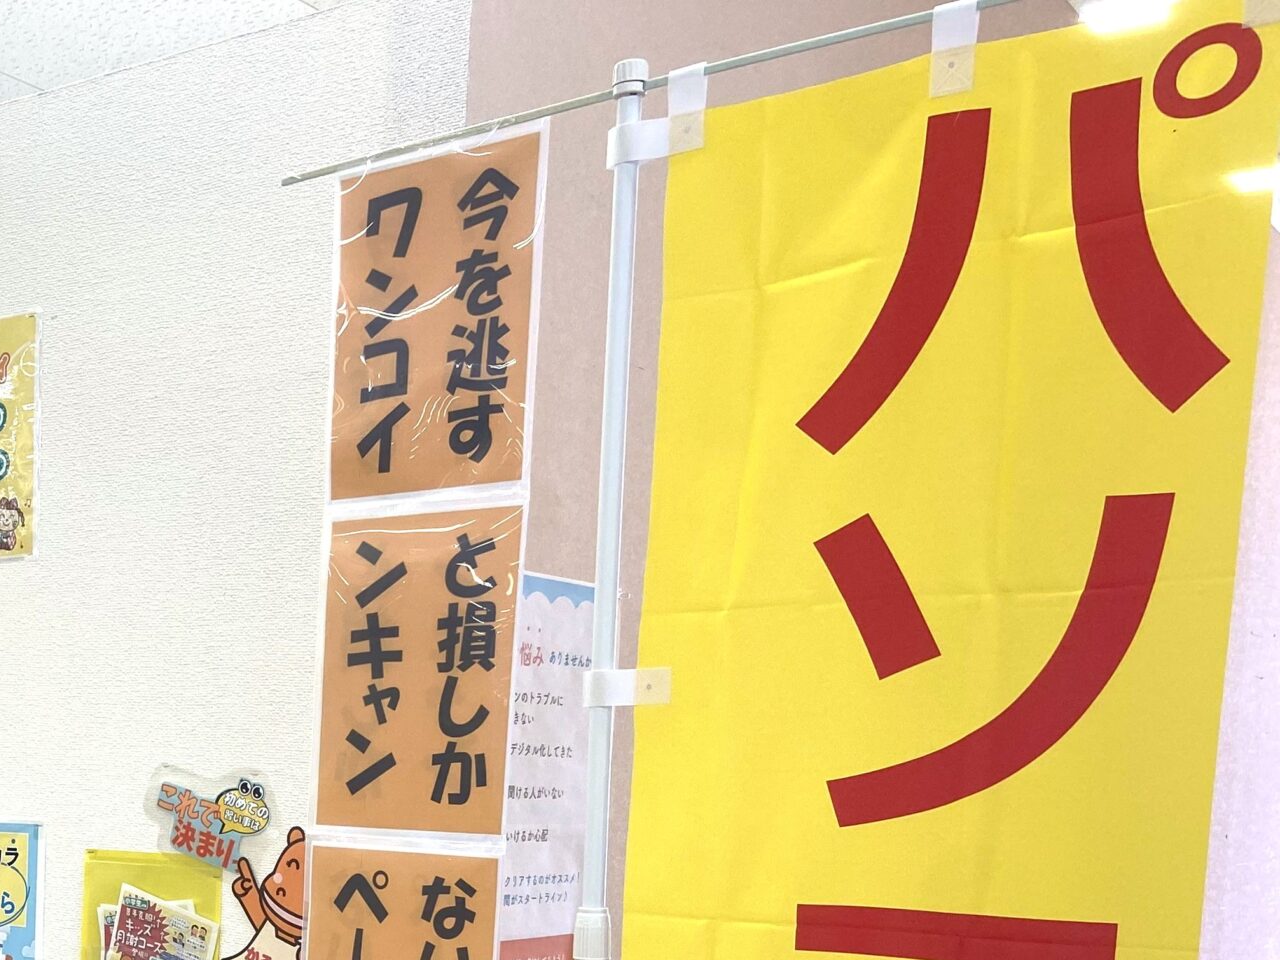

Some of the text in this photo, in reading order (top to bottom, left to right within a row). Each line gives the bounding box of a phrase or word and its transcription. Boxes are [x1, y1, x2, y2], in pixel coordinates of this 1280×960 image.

[356, 186, 423, 474] ワンコイ
[446, 167, 520, 464] 今を逃す
[345, 541, 408, 796] ンキャン
[430, 533, 497, 805] と損しか
[519, 641, 544, 667] 悩み
[157, 783, 220, 828] これで
[224, 792, 269, 820] 初めての
[507, 785, 564, 800] 聞ける人がいない
